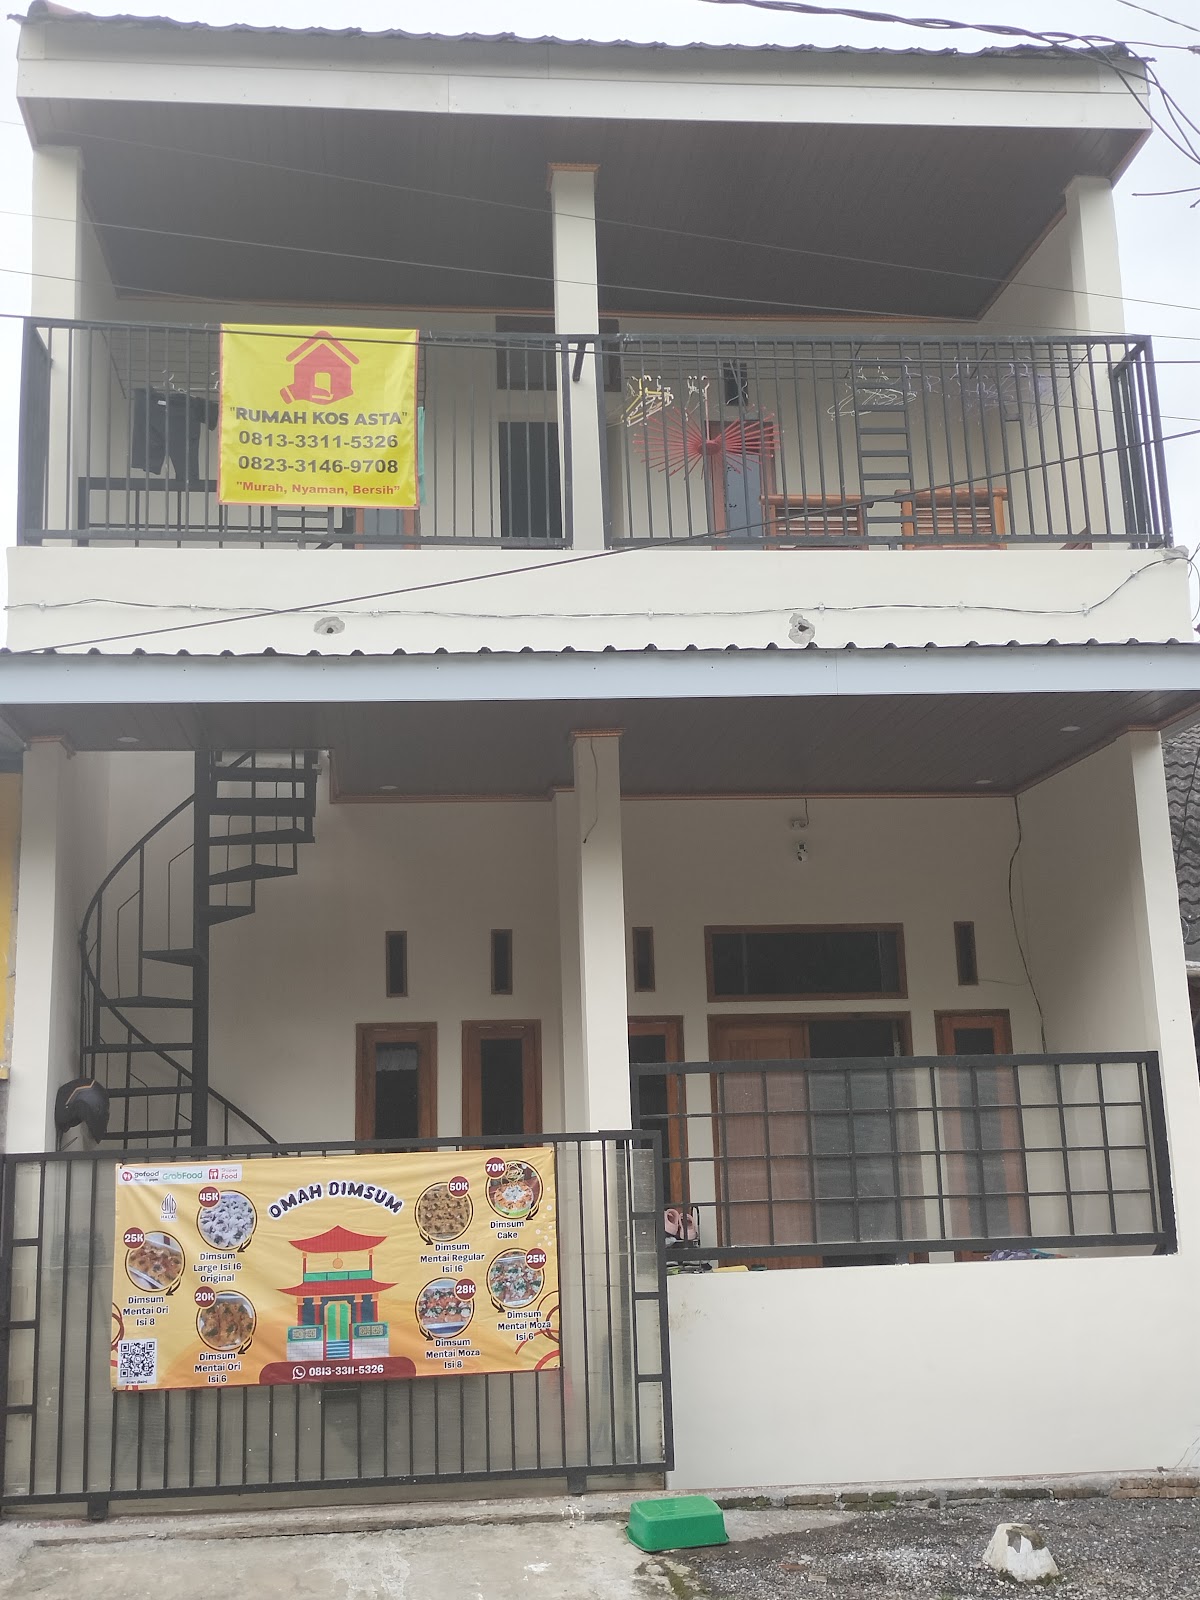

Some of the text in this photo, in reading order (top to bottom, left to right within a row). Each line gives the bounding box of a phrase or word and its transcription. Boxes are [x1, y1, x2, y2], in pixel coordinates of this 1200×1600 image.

[312, 411, 349, 425] KOS
[239, 430, 398, 448] 0813-3311-5326
[238, 455, 398, 473] 0823-3146-9708
[291, 484, 348, 496] Nyaman,
[486, 1163, 505, 1172] 70K
[134, 1170, 159, 1179] gofood
[162, 1171, 203, 1180] GrabFood
[449, 1182, 468, 1191] 50K
[268, 1181, 403, 1218] OMAH DIMSUM
[490, 1221, 524, 1229] Dimsum
[124, 1234, 144, 1243] 25K
[497, 1231, 518, 1239] Cake
[200, 1252, 236, 1260] Dimsum
[420, 1253, 485, 1263] Mentai Regular
[526, 1255, 546, 1263] 25K
[193, 1262, 242, 1273] Large Isi 16
[442, 1265, 453, 1273] Isi
[200, 1273, 235, 1284] Original
[456, 1285, 475, 1293] 28K
[128, 1296, 164, 1304] Dimsum
[195, 1292, 214, 1301] 20K
[122, 1306, 169, 1315] Mentai Ori
[507, 1311, 542, 1319] Dimsum
[136, 1318, 155, 1326] Isi 8
[497, 1320, 551, 1330] Mentai Moza
[516, 1332, 534, 1341] Isi 6
[435, 1339, 471, 1347] Dimsum
[199, 1352, 236, 1361] Dimsum
[426, 1349, 455, 1358] Mentai
[194, 1363, 241, 1372] Mentai Ori
[444, 1360, 463, 1369] Isi 8
[308, 1364, 384, 1376] 0813-3311-5326
[208, 1374, 227, 1383] Isi 6
